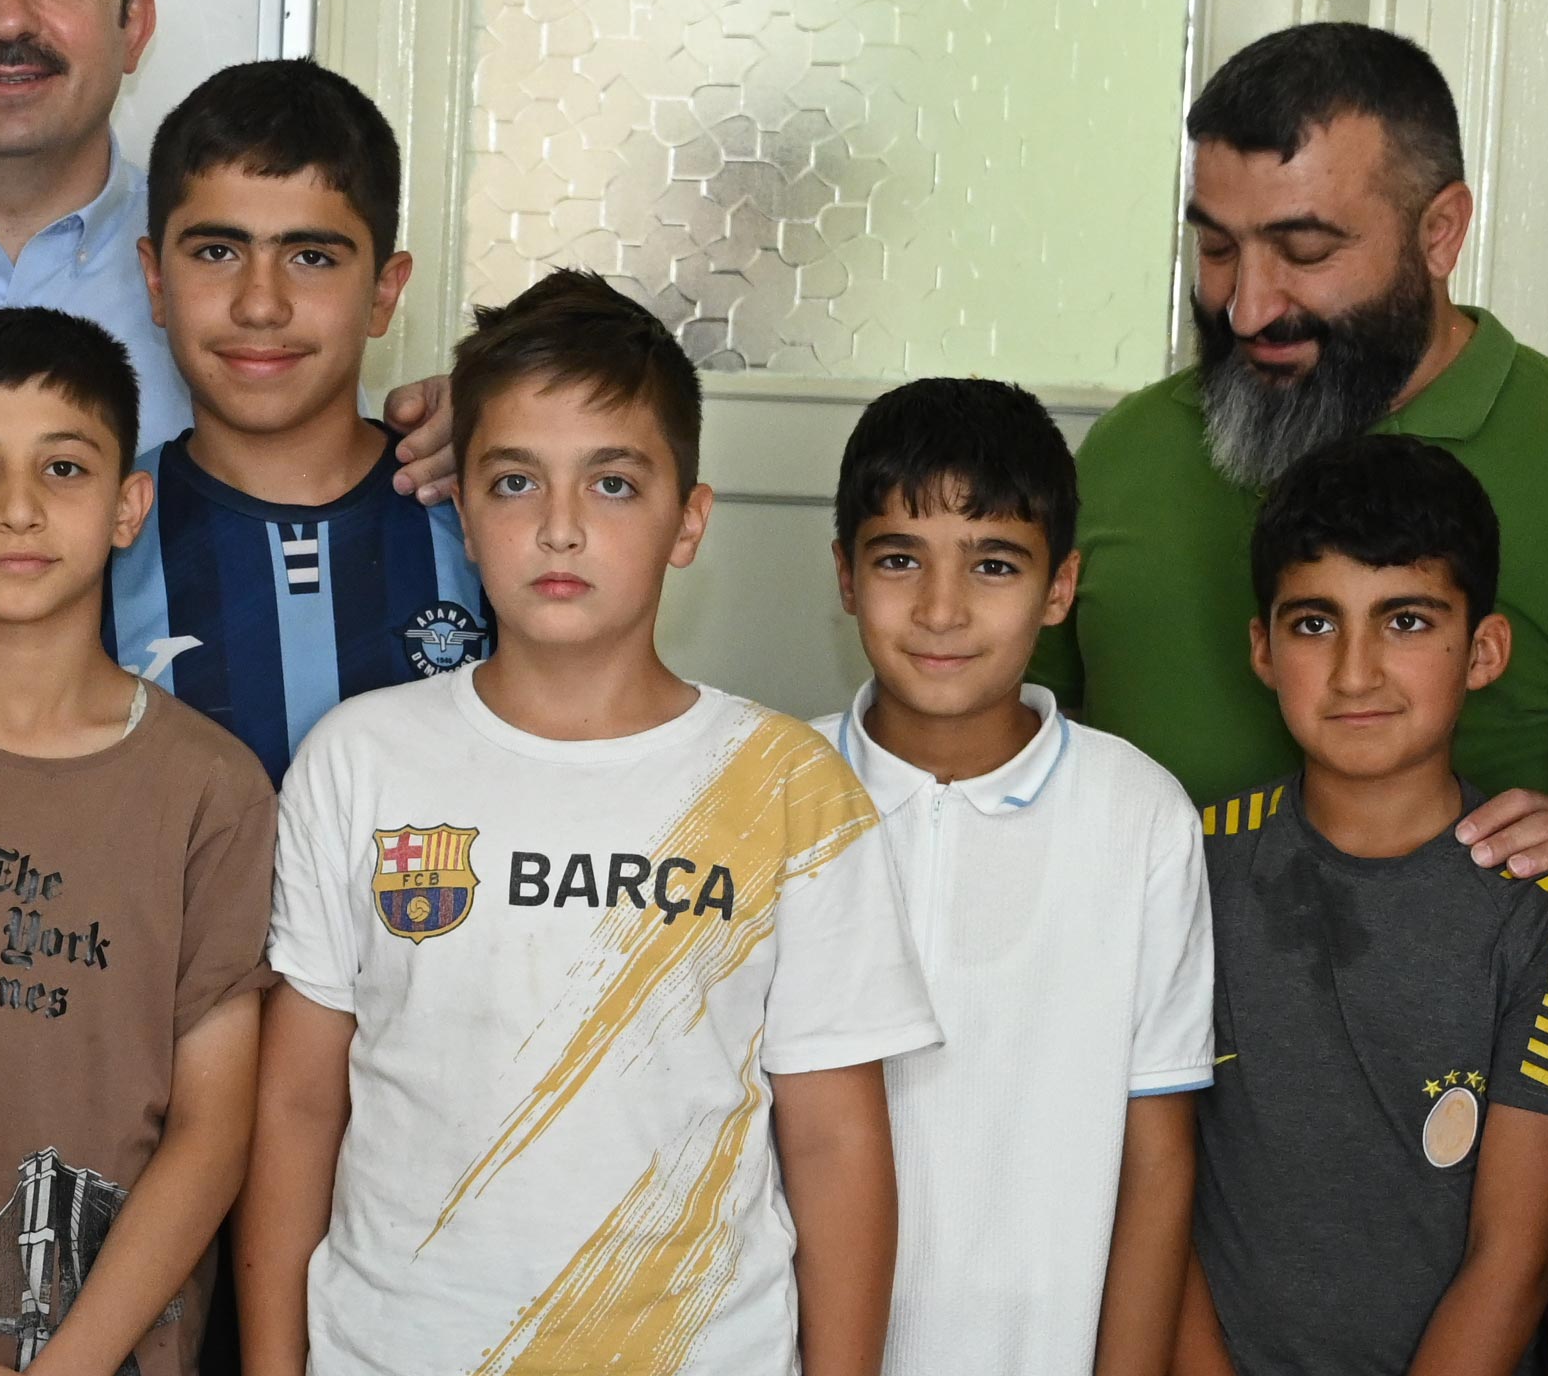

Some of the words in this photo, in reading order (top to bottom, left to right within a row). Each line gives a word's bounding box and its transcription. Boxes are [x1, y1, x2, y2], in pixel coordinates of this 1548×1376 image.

[417, 608, 466, 628] ADANA
[402, 872, 441, 886] FCB
[508, 851, 736, 925] BARÇA
[3, 905, 111, 971] York
